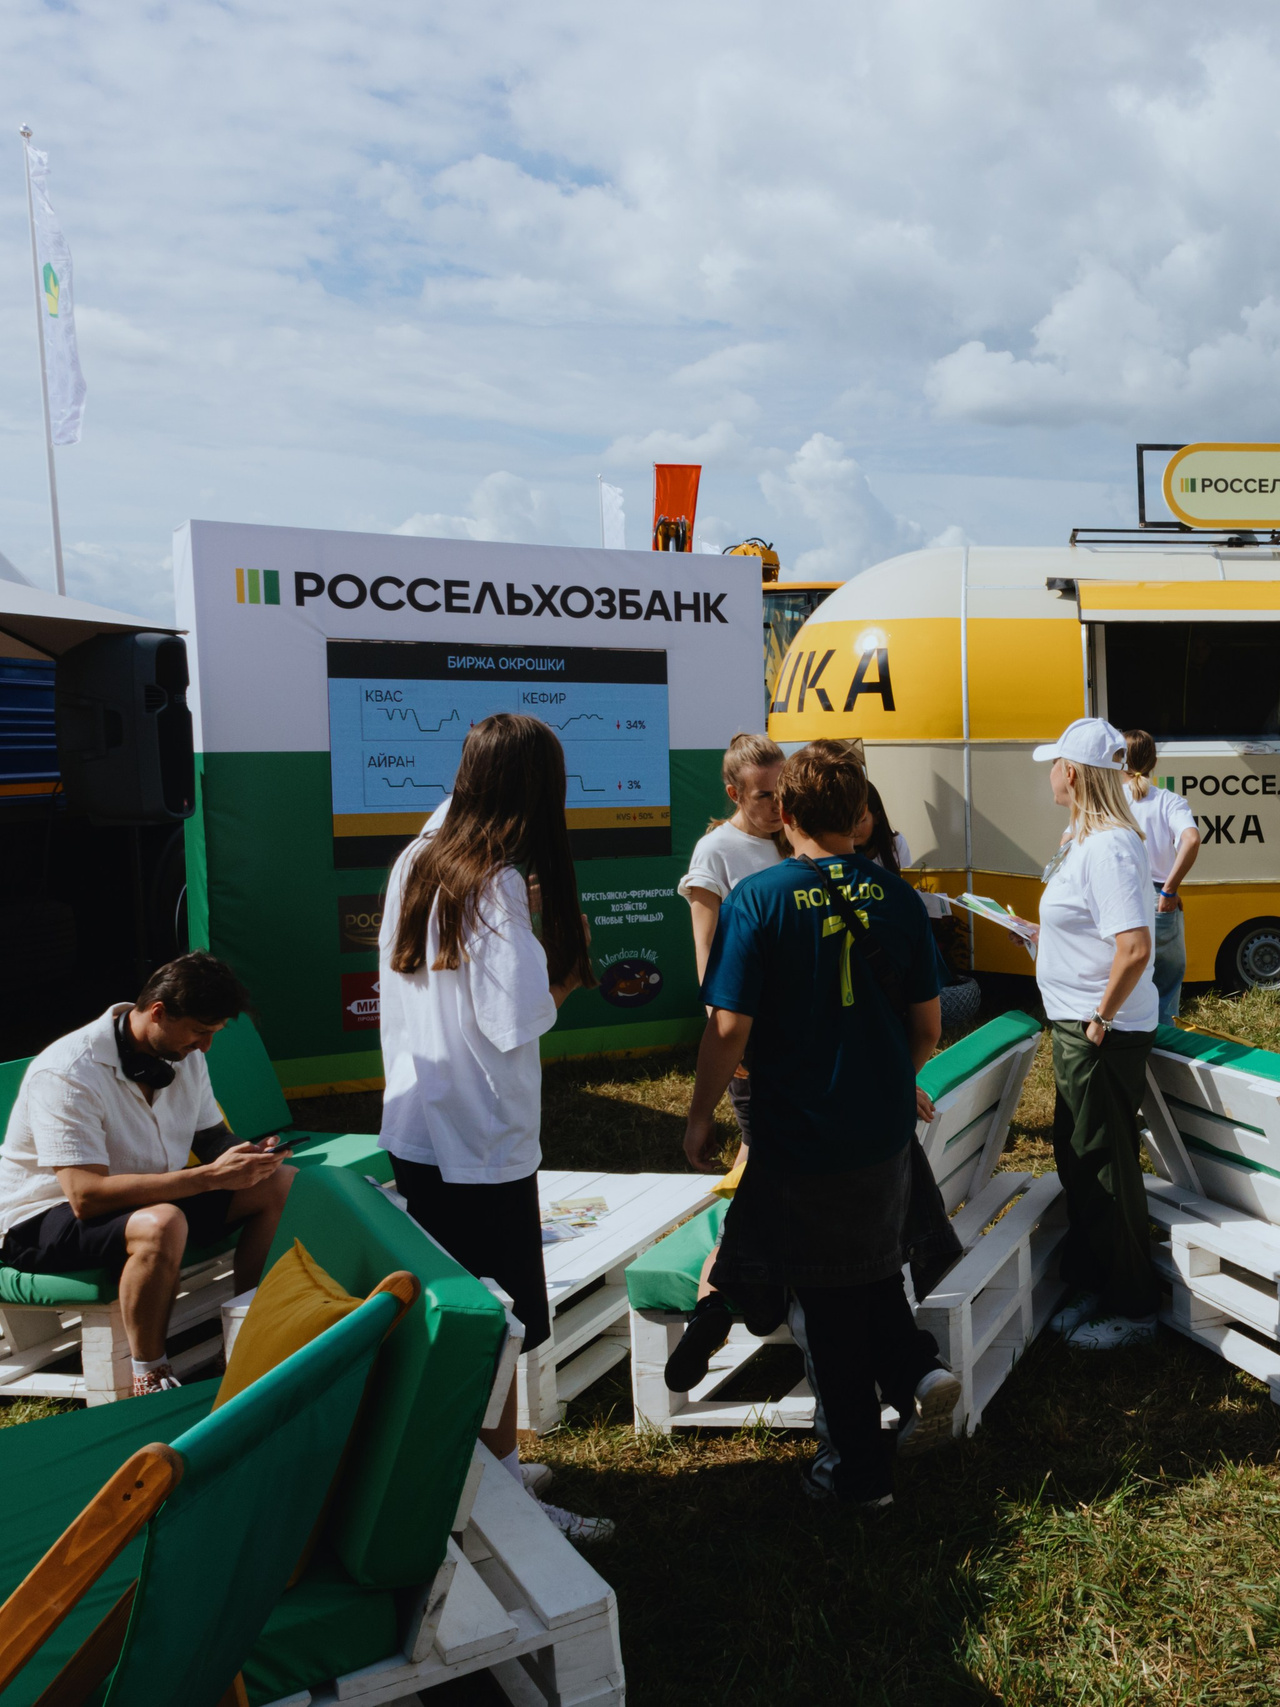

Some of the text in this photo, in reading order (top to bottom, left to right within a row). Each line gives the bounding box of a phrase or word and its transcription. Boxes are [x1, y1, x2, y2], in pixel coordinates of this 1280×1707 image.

[294, 571, 729, 624] РОССЕЛЬХОЗБАНК
[447, 656, 566, 671] БИРЖА ОКРОШКИ
[365, 689, 404, 702] КВАС
[522, 692, 567, 704] КЕФИР
[625, 720, 646, 730] 34%
[367, 753, 415, 768] АЙРАН
[627, 780, 641, 790] 3%
[1193, 814, 1265, 844] ЖА
[599, 947, 659, 967] Mendoza Milk
[356, 1000, 380, 1013] МИ
